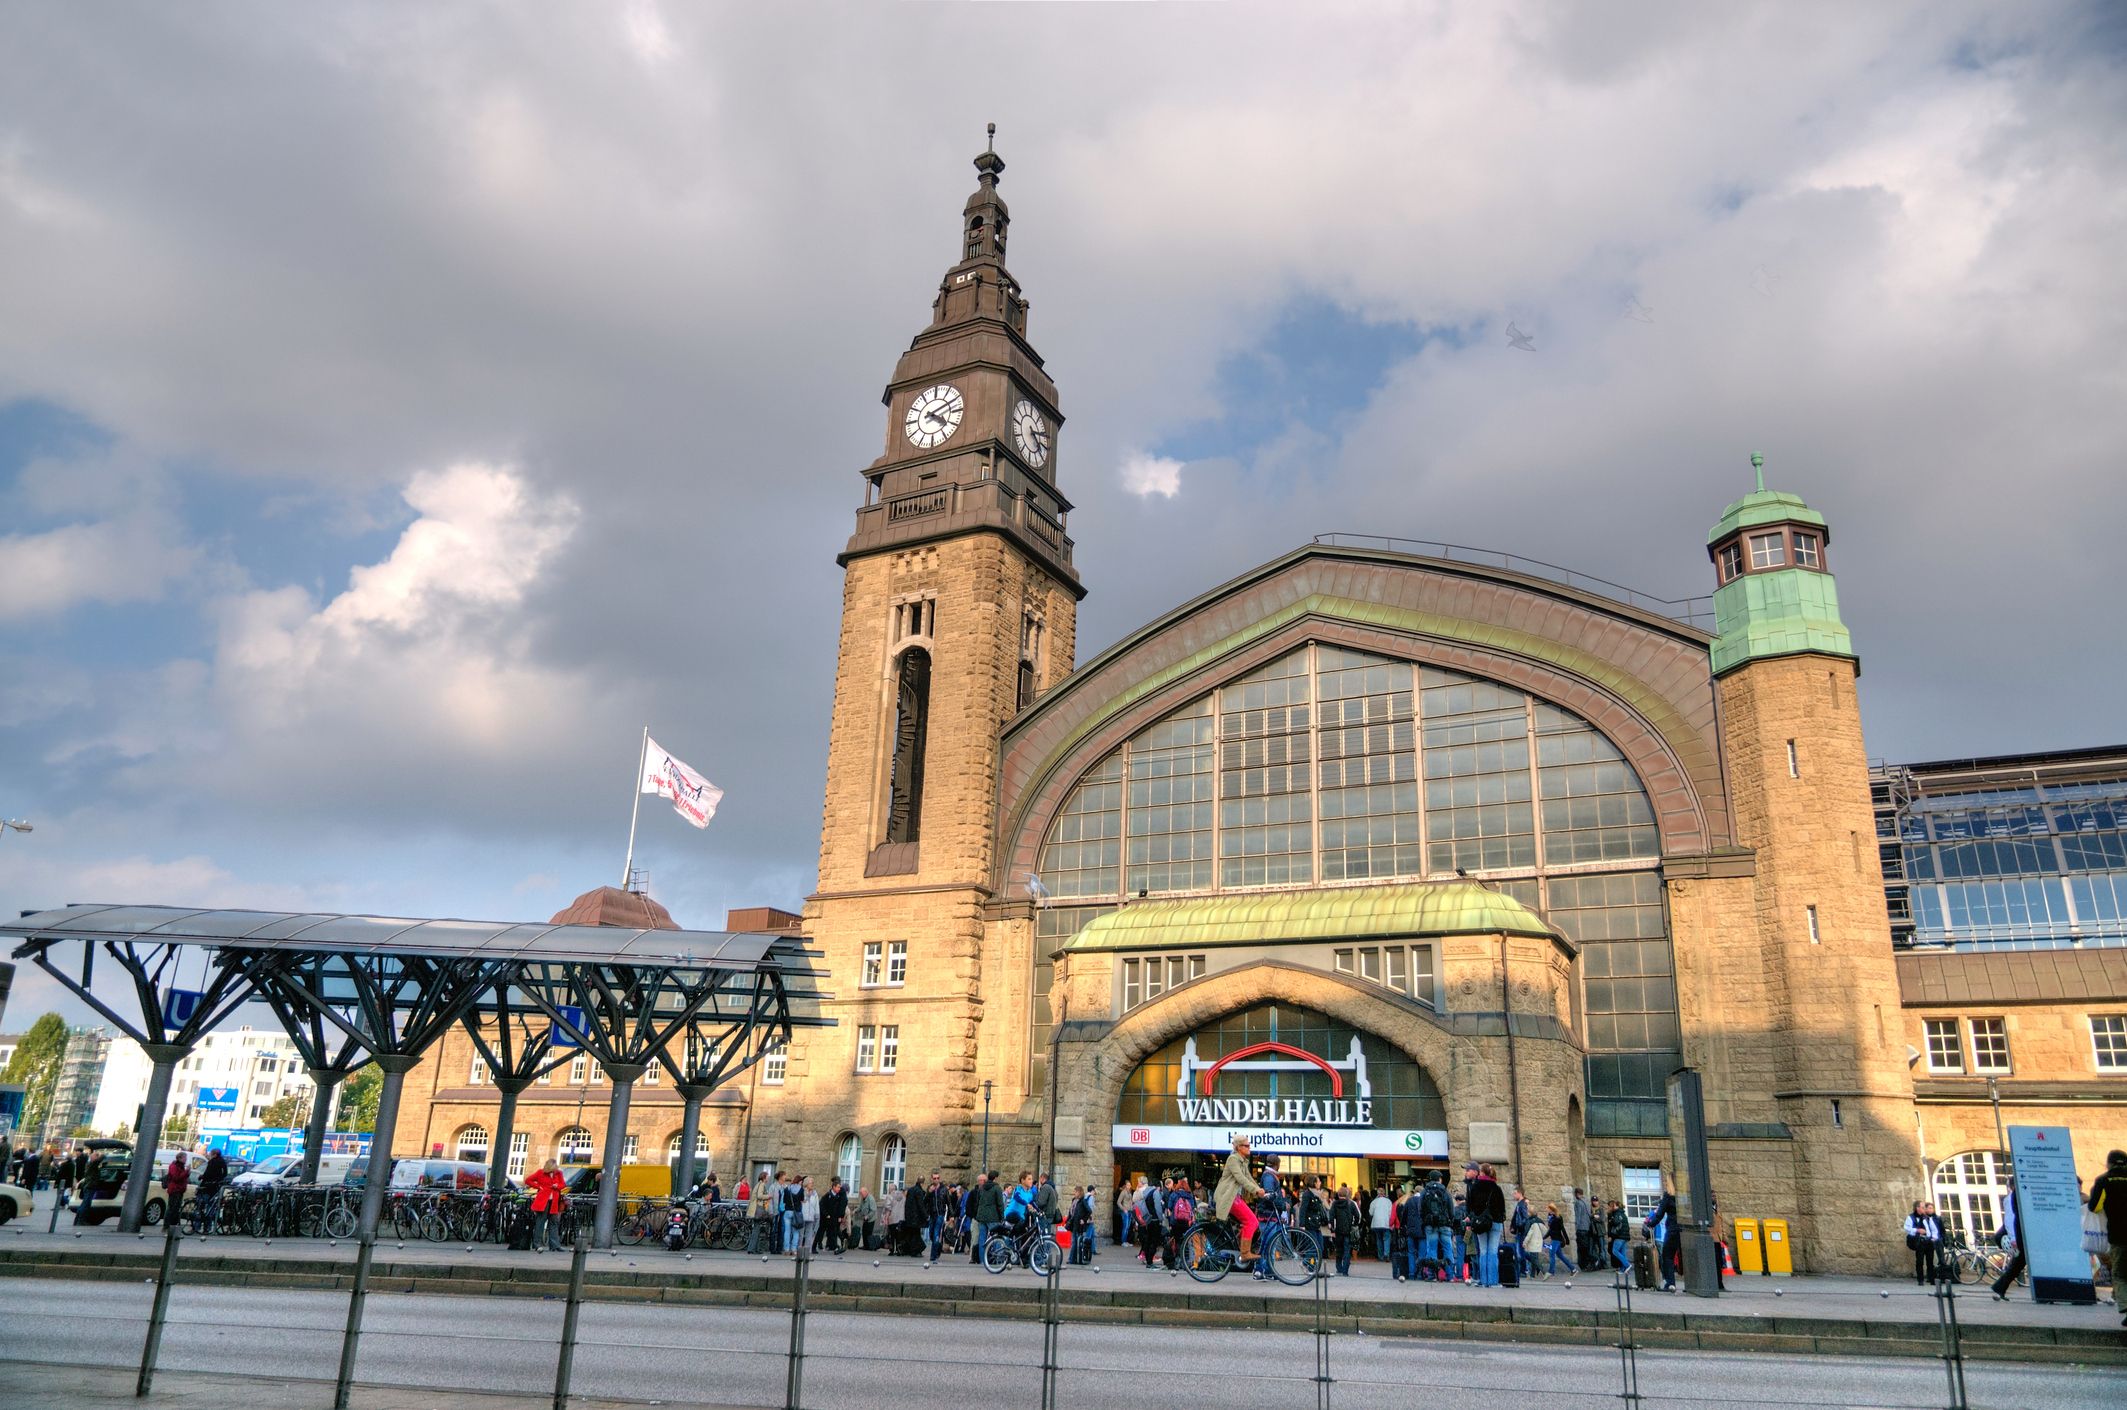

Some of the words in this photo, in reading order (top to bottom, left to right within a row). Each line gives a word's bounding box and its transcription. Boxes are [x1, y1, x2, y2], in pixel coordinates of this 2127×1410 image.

[171, 993, 200, 1027] U
[1176, 1098, 1374, 1125] WANDELHALLE
[1132, 1130, 1148, 1142] DB
[1228, 1131, 1323, 1148] Huptbahnhof
